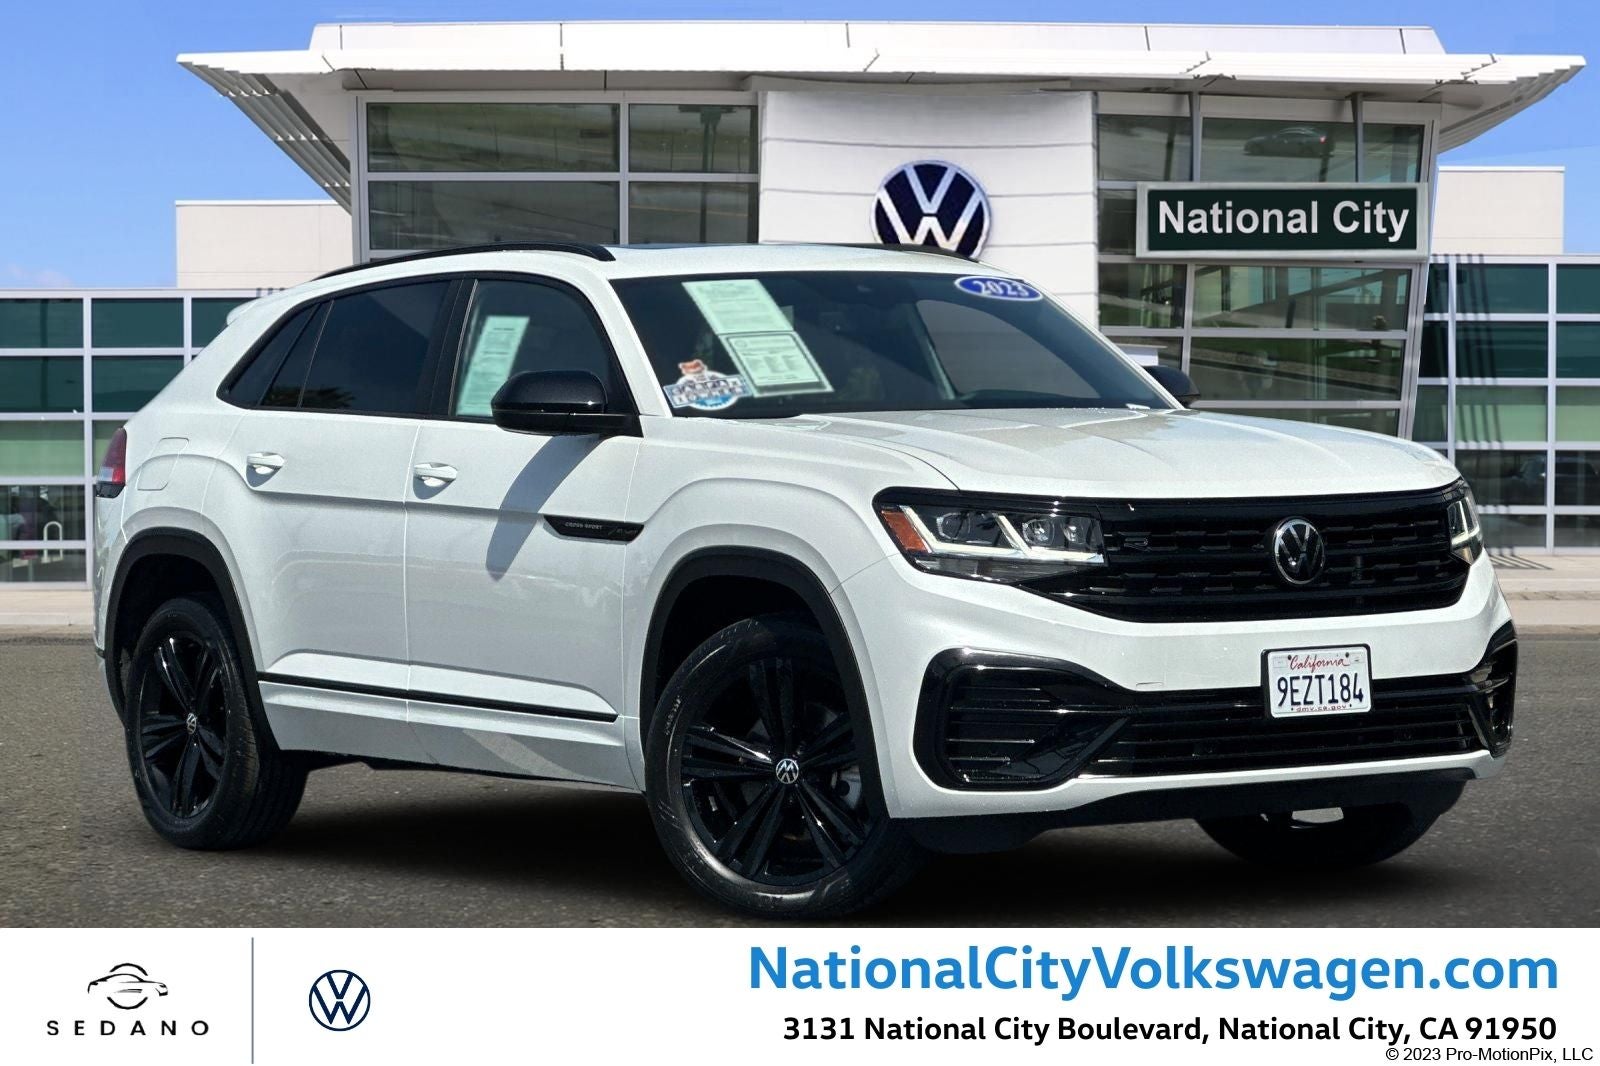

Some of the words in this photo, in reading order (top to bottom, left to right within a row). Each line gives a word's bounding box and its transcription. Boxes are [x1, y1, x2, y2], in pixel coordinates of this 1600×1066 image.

[1158, 200, 1318, 234] National
[1332, 200, 1410, 243] City
[972, 280, 1029, 297] 2023
[1290, 654, 1350, 673] California
[1277, 672, 1364, 707] 9EZT184
[1296, 704, 1347, 712] dmv.ca.gov
